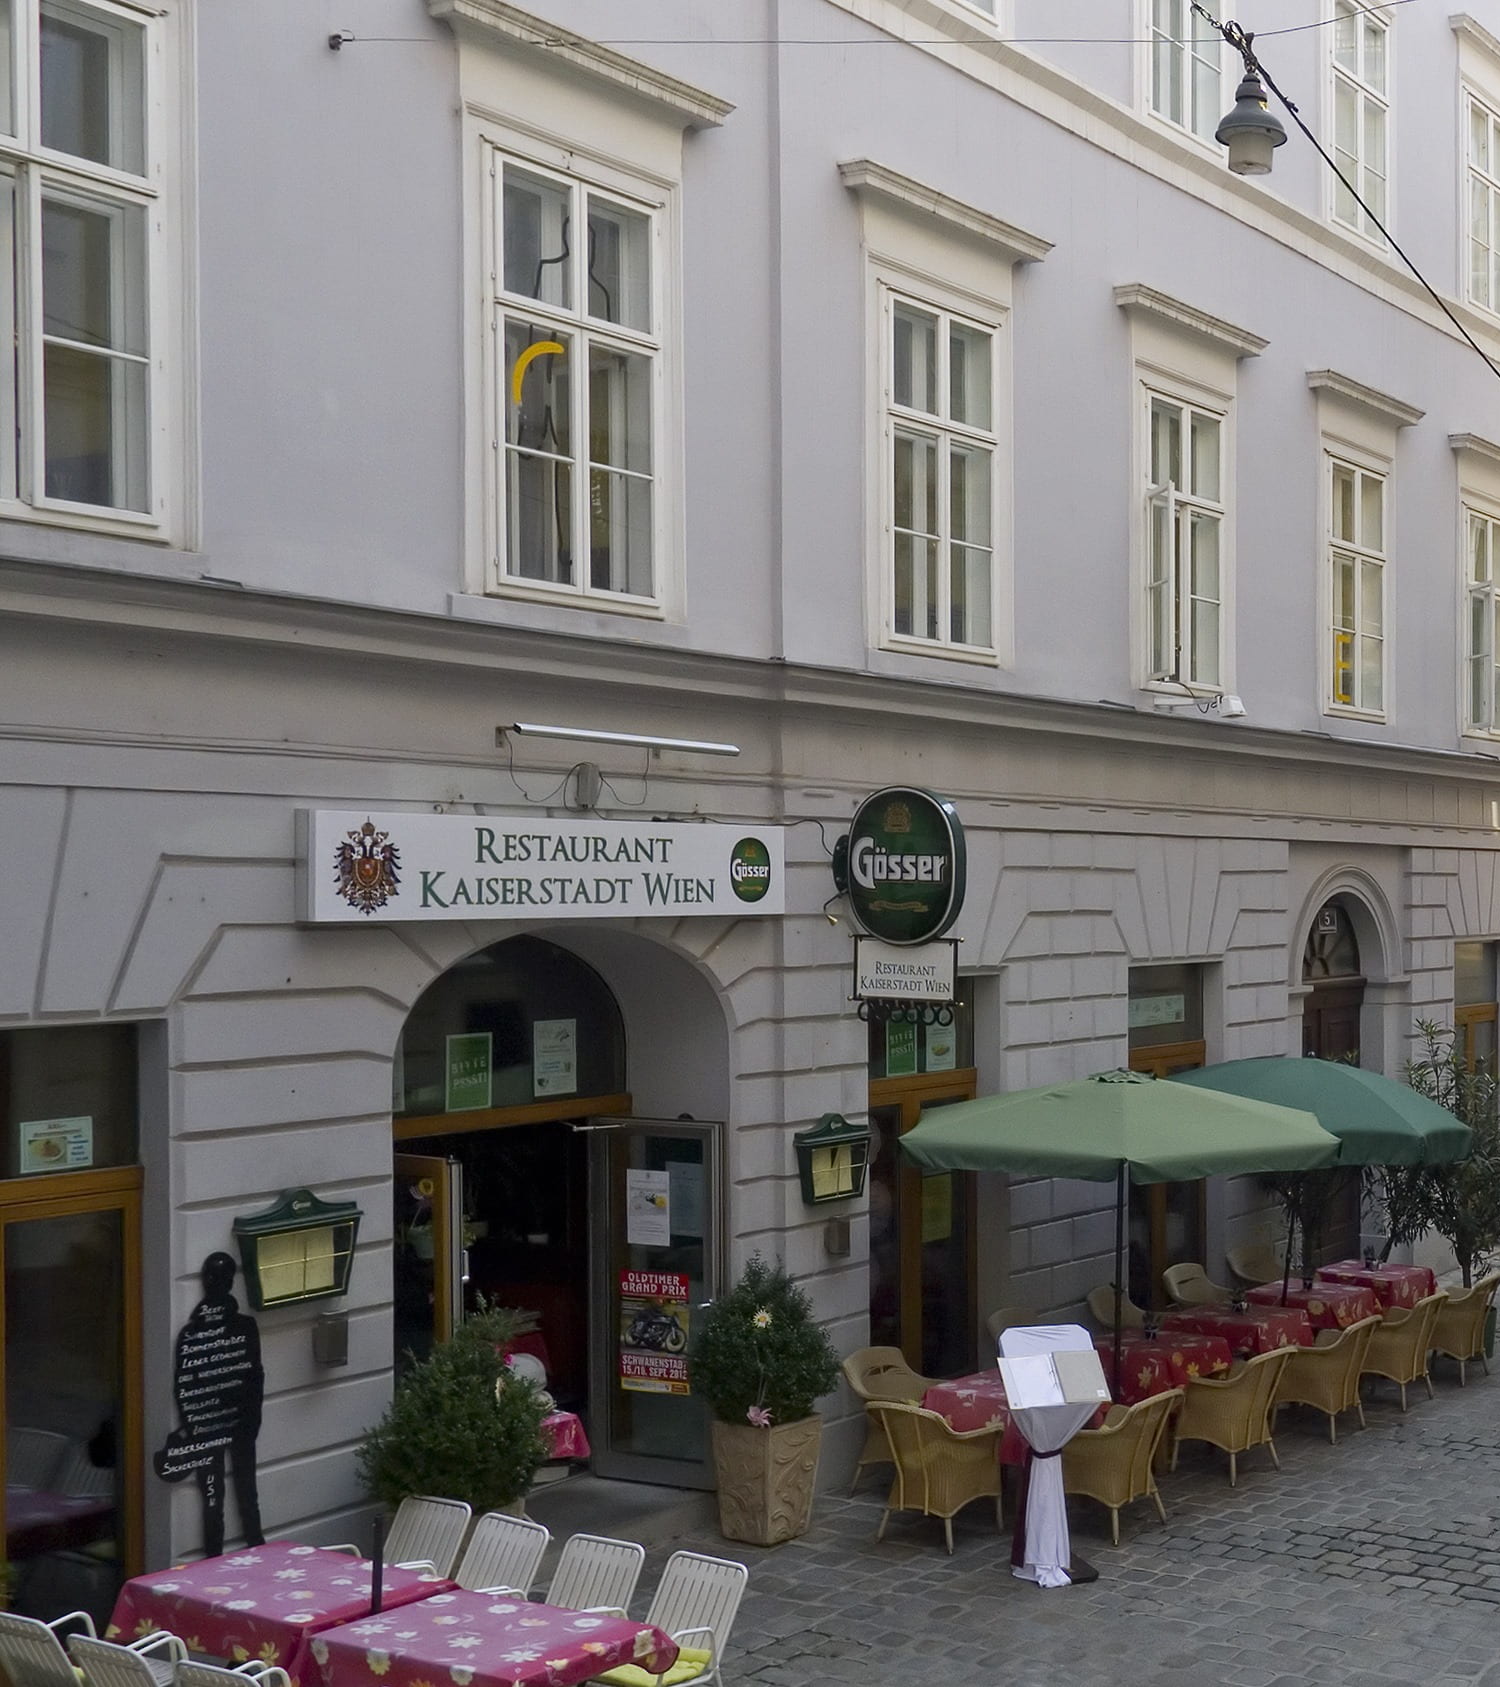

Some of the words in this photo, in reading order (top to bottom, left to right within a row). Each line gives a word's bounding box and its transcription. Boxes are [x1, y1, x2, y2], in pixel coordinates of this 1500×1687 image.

[475, 827, 673, 864] RESTAURANT
[731, 858, 769, 882] Gösser
[851, 837, 947, 889] Gösser
[419, 871, 633, 908] KAISERSTADT
[642, 872, 715, 906] WIEN
[1324, 911, 1330, 926] 5
[875, 961, 936, 976] RESTAURANT
[860, 976, 923, 991] KAISERSTADT
[925, 979, 951, 993] WIEN
[628, 1272, 680, 1286] OLDTIMER
[622, 1281, 657, 1294] GRAND
[662, 1284, 686, 1296] PRIX
